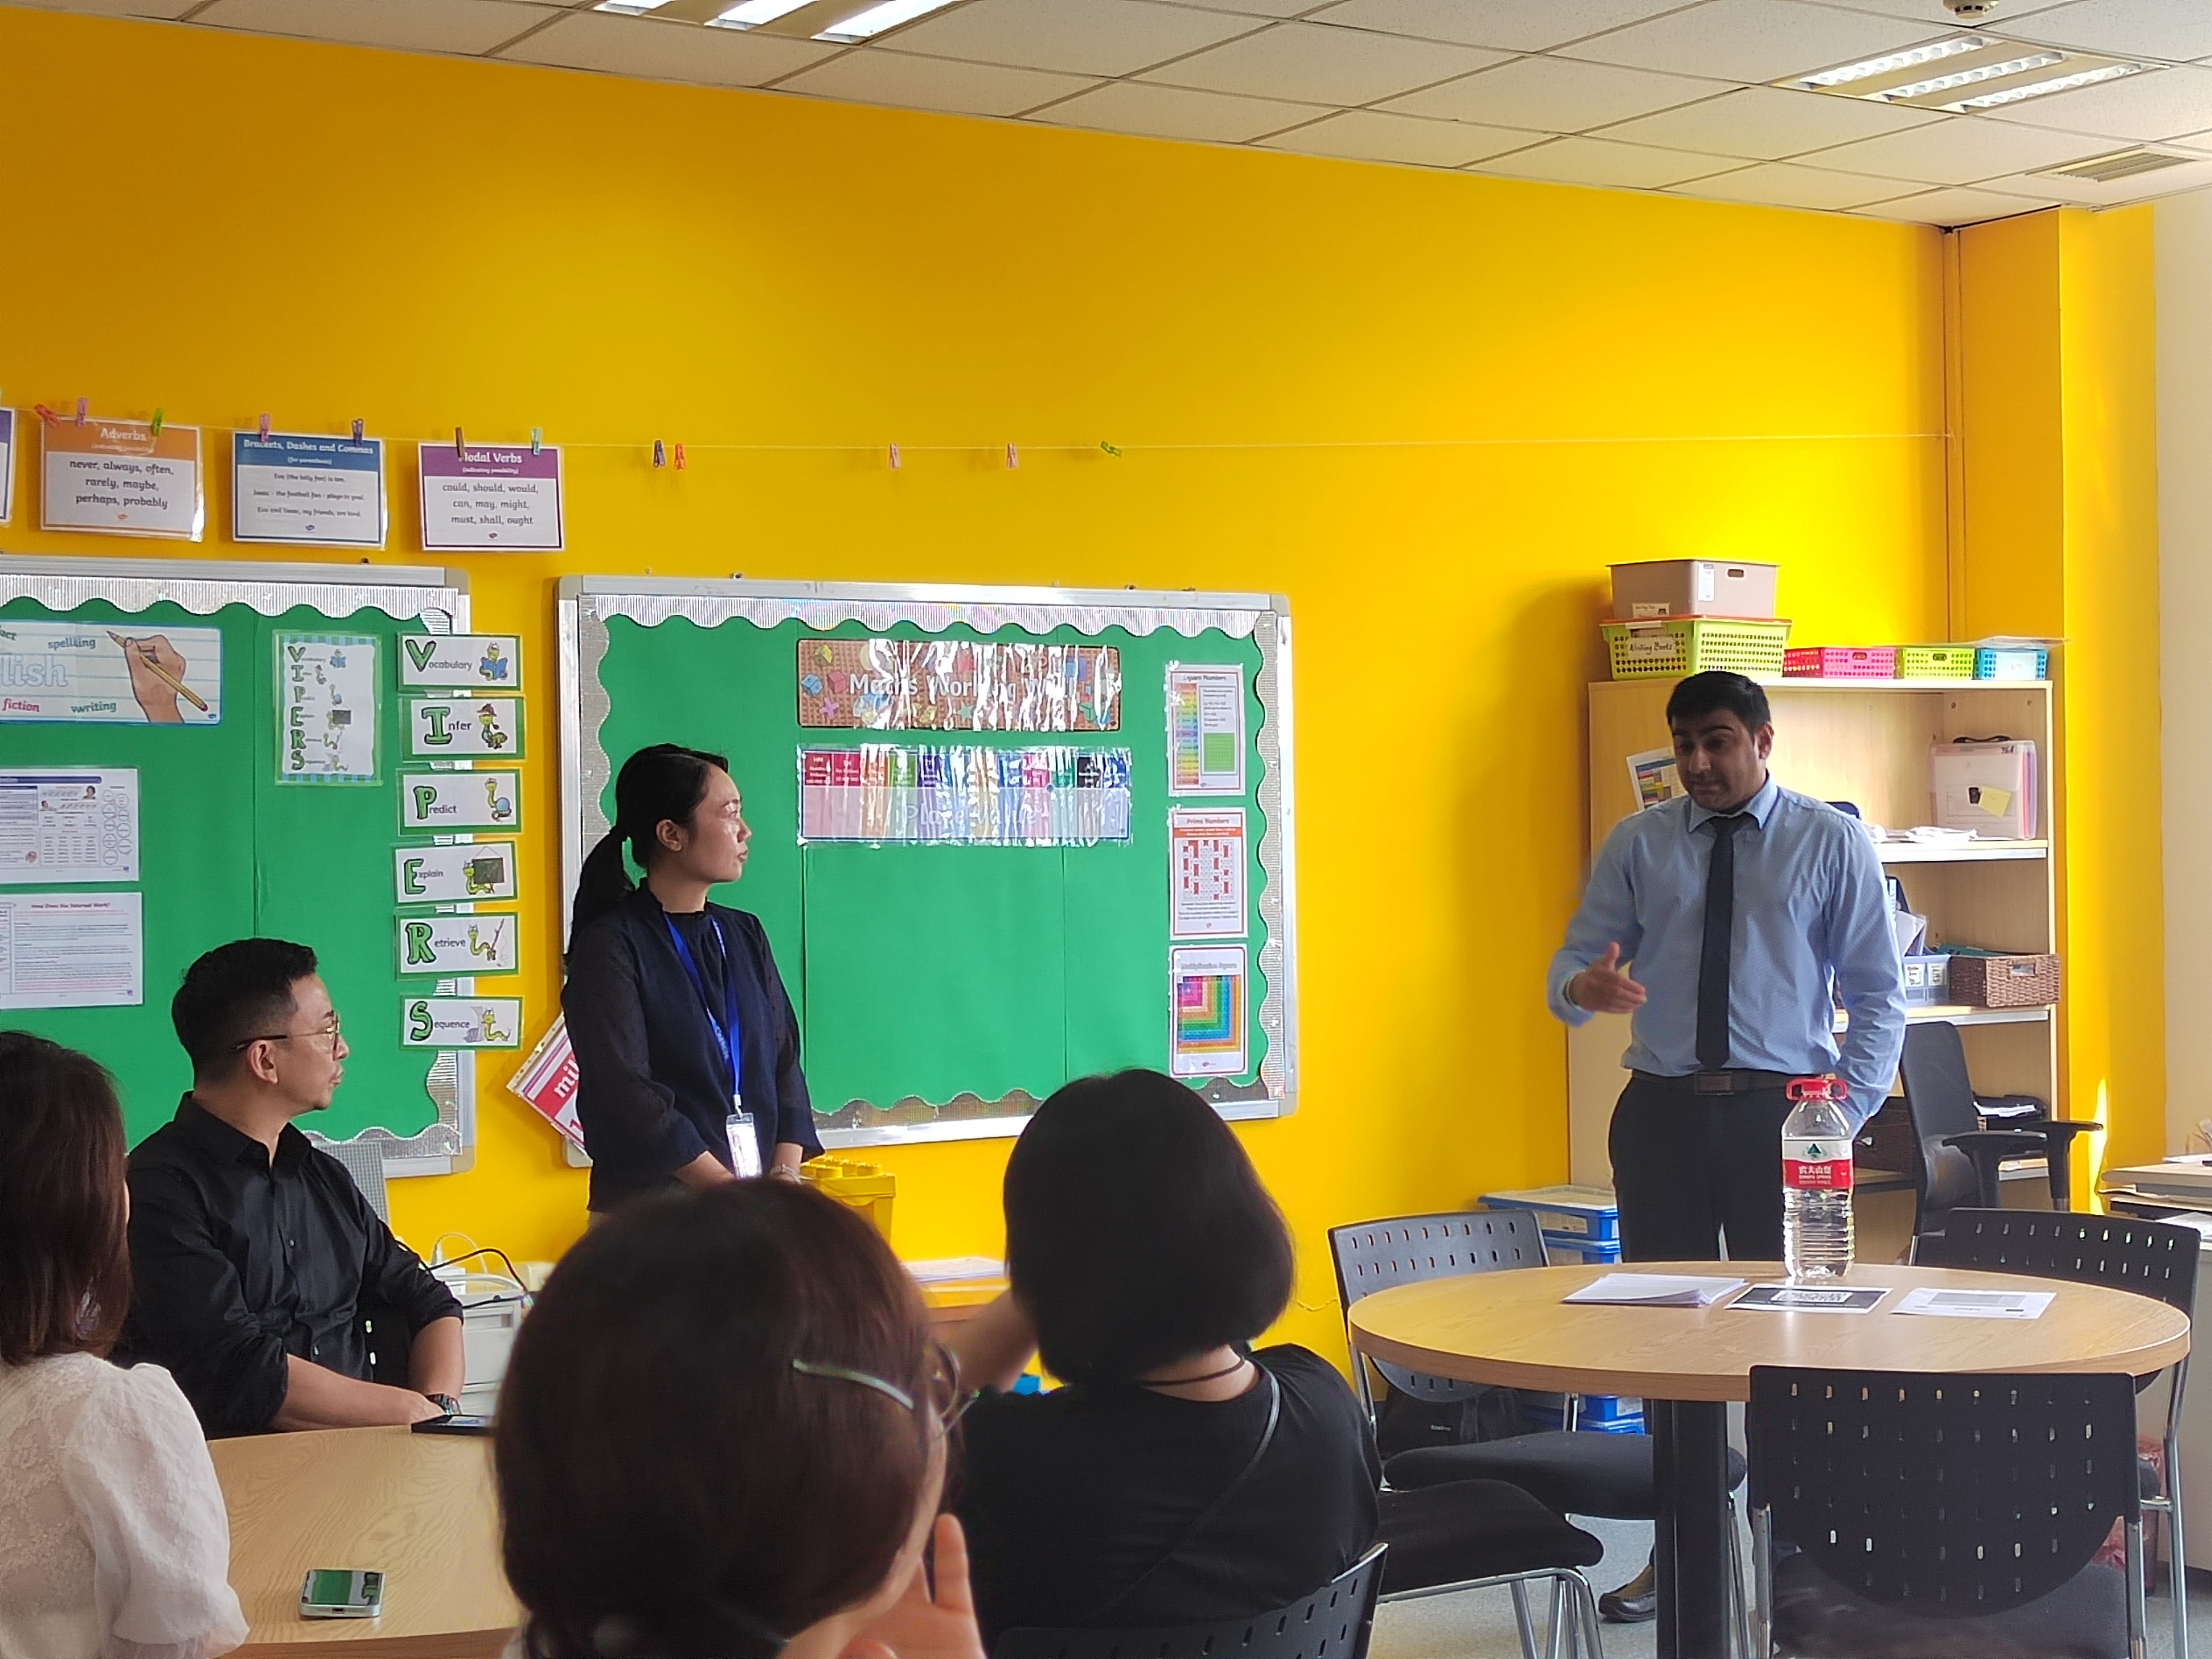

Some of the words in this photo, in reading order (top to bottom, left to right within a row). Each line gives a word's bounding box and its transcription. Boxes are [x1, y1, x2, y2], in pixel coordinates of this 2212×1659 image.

[100, 428, 147, 441] Adverbs
[287, 441, 317, 451] Dashes
[319, 444, 335, 452] and
[492, 453, 523, 463] Verbs
[69, 460, 100, 470] never,
[103, 461, 142, 474] always,
[145, 463, 173, 475] often,
[86, 478, 119, 489] rarely,
[123, 480, 159, 491] maybe,
[443, 483, 470, 493] could,
[473, 483, 506, 494] should,
[508, 484, 539, 494] would,
[75, 494, 120, 506] perhaps,
[124, 496, 168, 510] probably
[453, 500, 472, 509] can,
[475, 502, 497, 511] may,
[500, 500, 530, 511] might,
[452, 516, 477, 525] must,
[479, 515, 504, 525] shall,
[507, 516, 534, 526] ought
[0, 629, 16, 641] act
[405, 639, 473, 672] Vocabulary
[0, 654, 68, 687] lish
[926, 675, 1016, 704] Worng
[3, 698, 40, 712] fiction
[421, 706, 472, 745] Infer
[413, 785, 457, 820] Predict
[907, 802, 964, 824] Plae
[404, 858, 444, 895] Explain
[405, 922, 466, 965] Retrieve
[410, 1001, 470, 1041] Sequence
